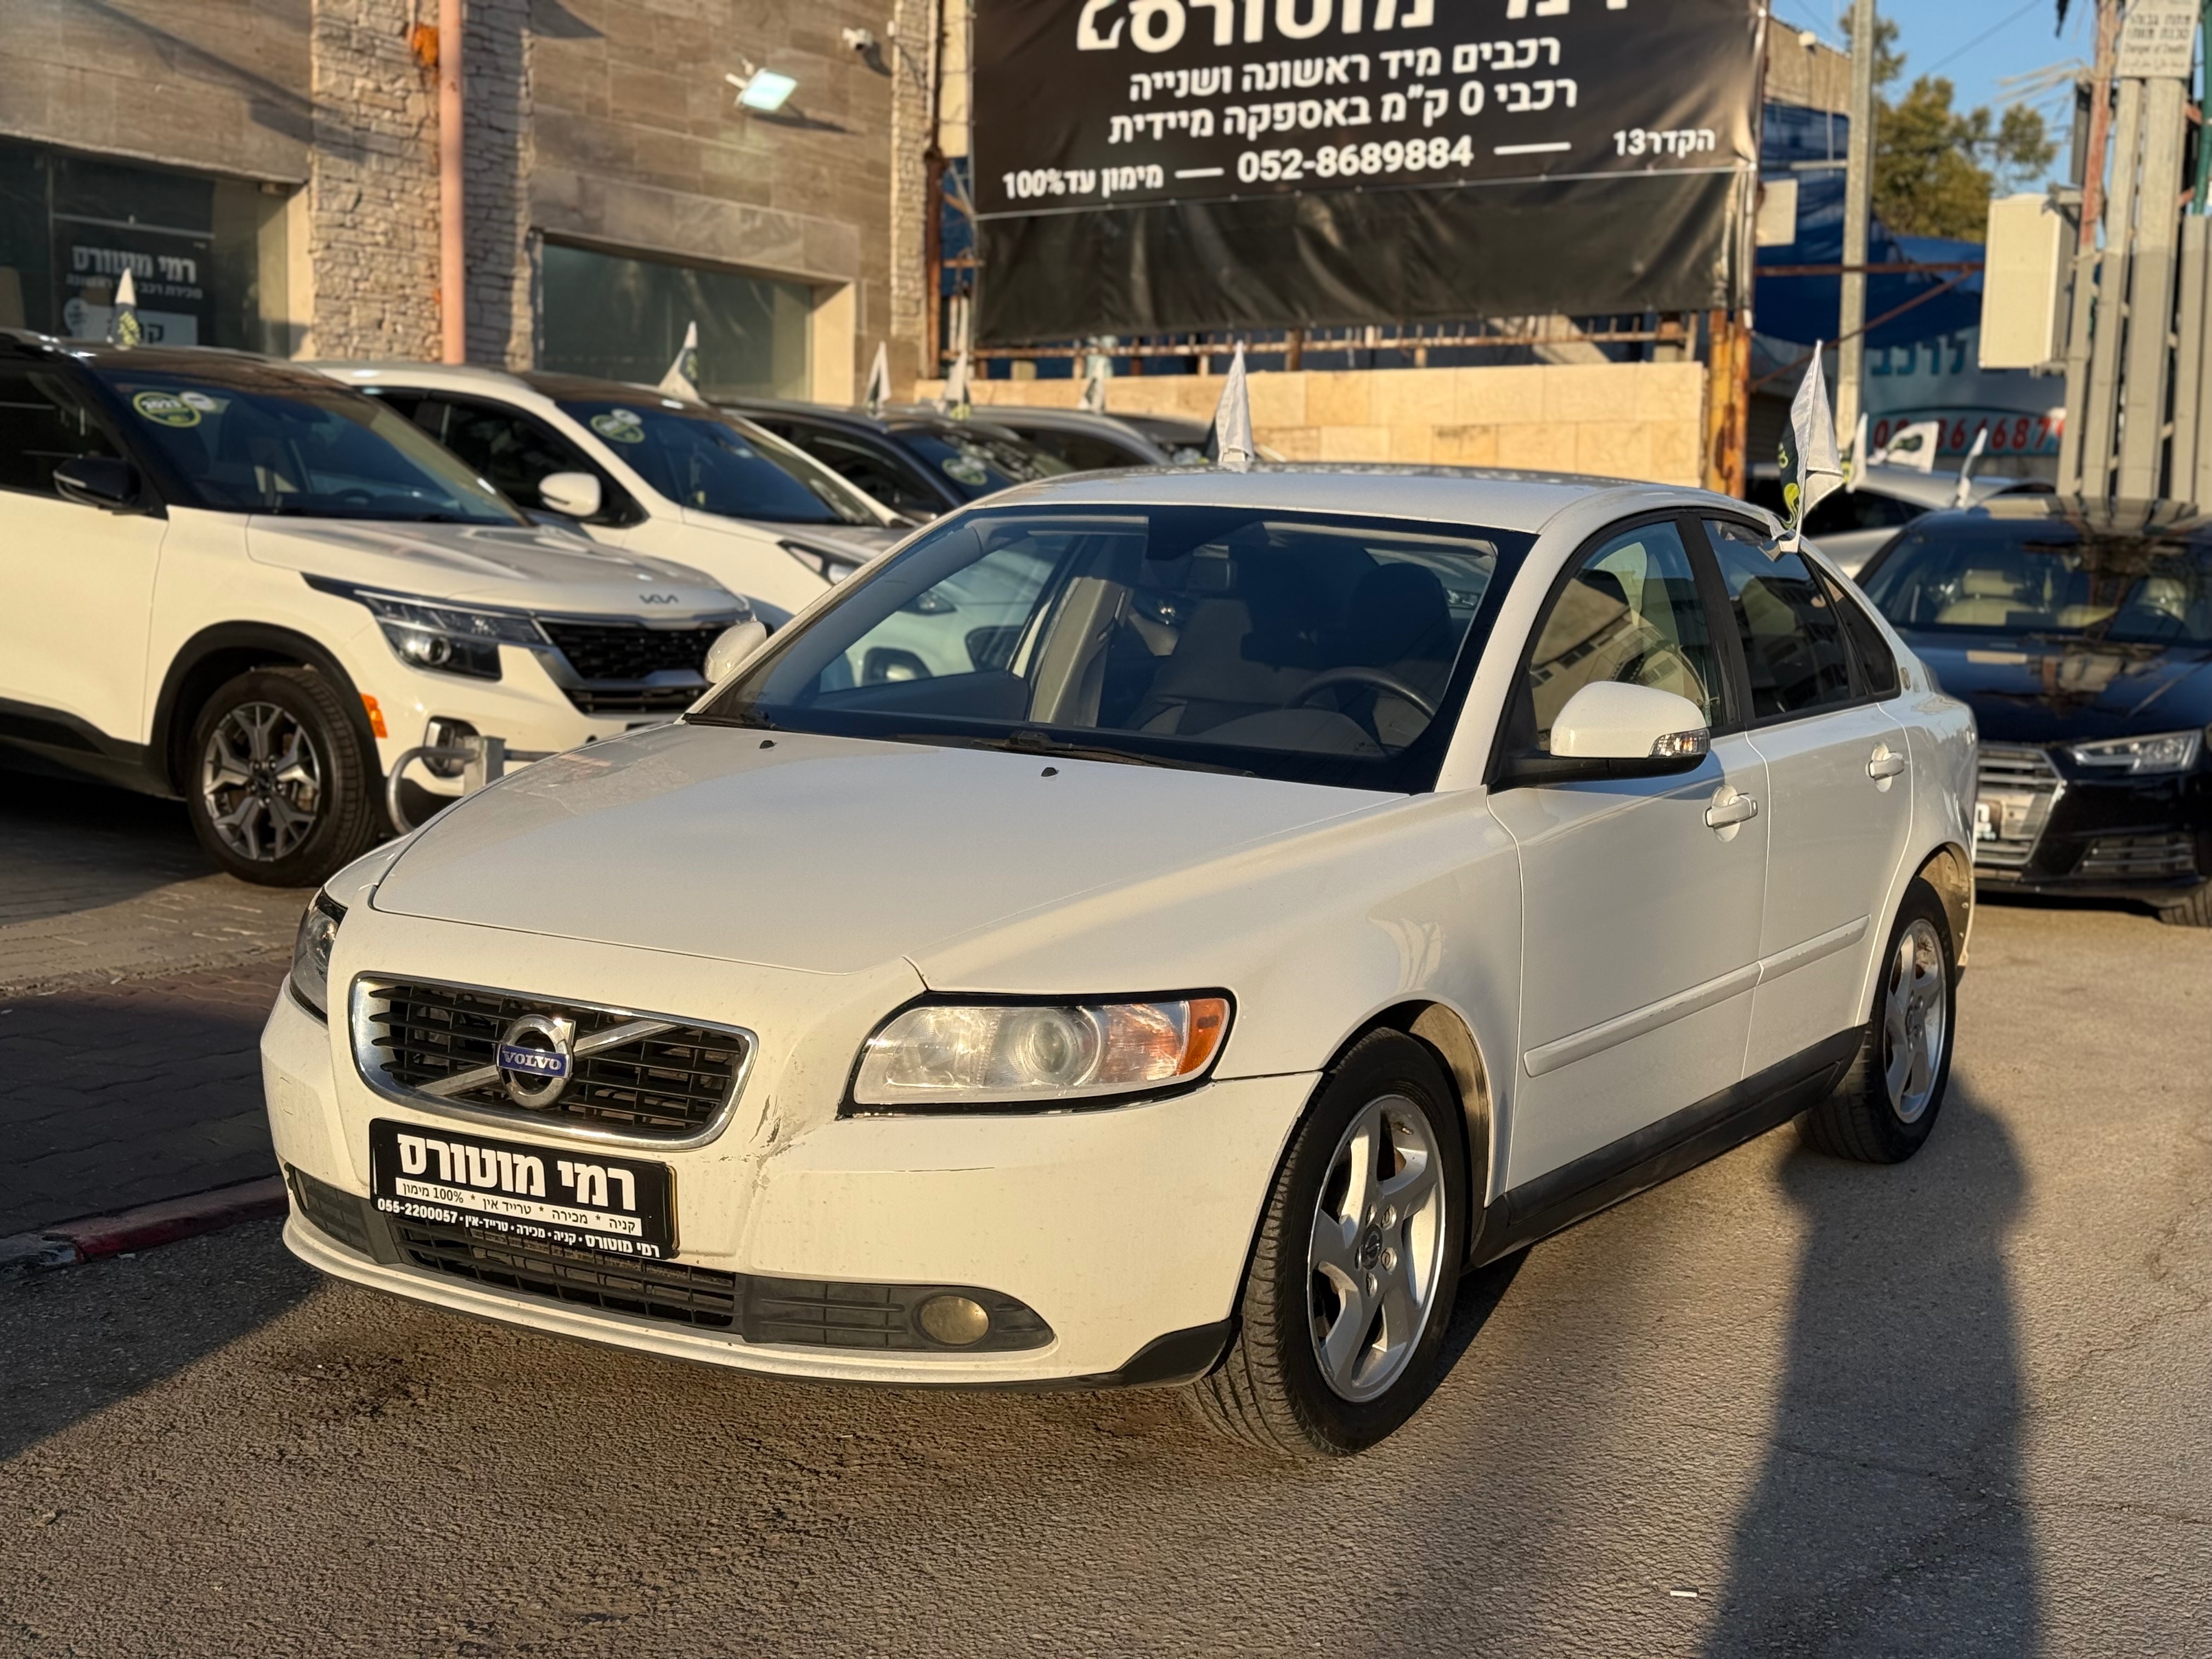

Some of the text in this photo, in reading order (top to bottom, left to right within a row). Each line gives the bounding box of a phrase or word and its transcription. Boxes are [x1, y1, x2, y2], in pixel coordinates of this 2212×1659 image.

[1130, 37, 1560, 101] רכבים מיד ראשונה ושנייה
[1460, 81, 1484, 115] 0
[1494, 79, 1577, 111] רכבי
[1109, 109, 1214, 143] מיידית
[1224, 97, 1371, 140] באספקה
[1238, 136, 1474, 182] 052-8689884
[1102, 165, 1163, 198] מימון
[157, 255, 196, 284] רמי
[501, 1050, 562, 1070] VOLVO
[398, 1134, 635, 1211] רמי מוטורס
[377, 1198, 458, 1223] 055-2200057
[403, 1183, 635, 1233] קניה מכירה טרייד אין 100% מימון
[516, 1224, 545, 1238] מכירה
[554, 1231, 576, 1245] קניה
[585, 1235, 633, 1253] מוטורס
[636, 1243, 660, 1258] רמי
